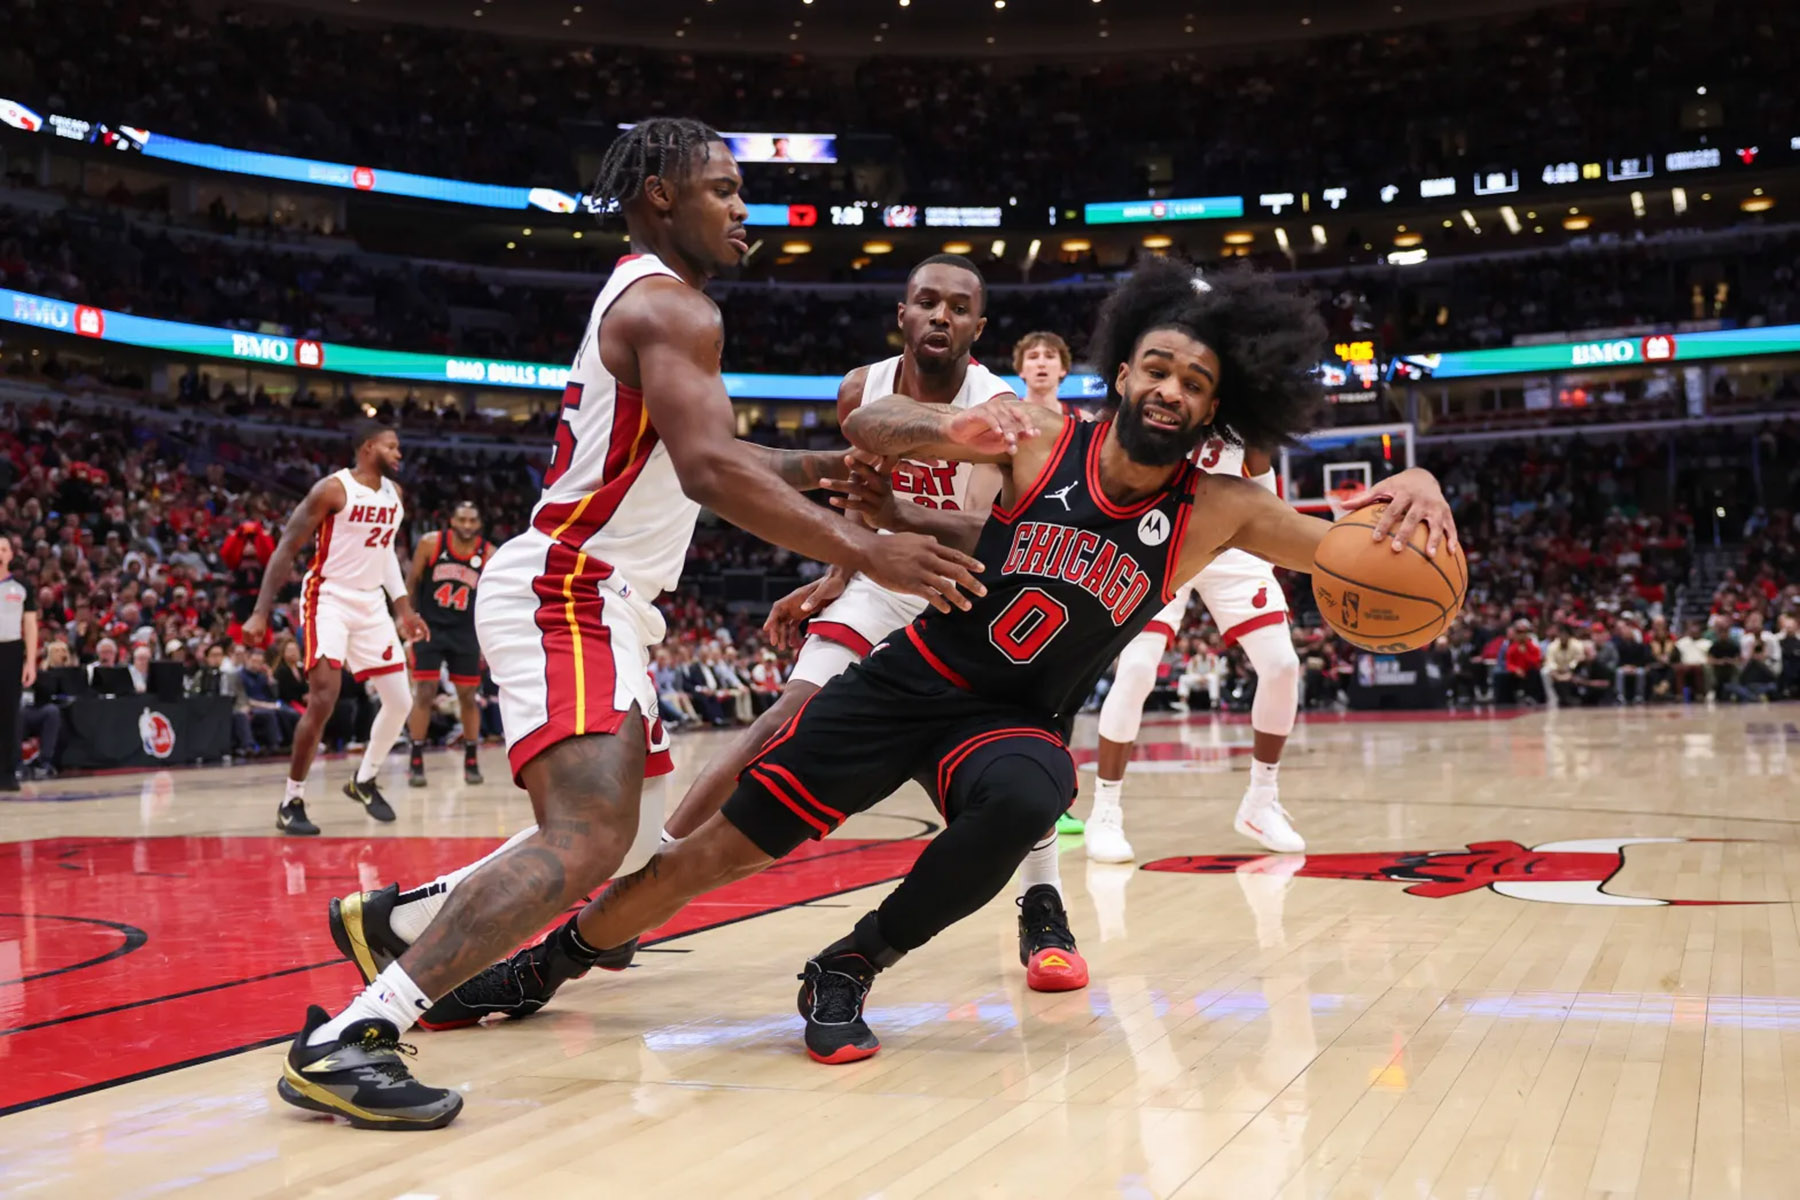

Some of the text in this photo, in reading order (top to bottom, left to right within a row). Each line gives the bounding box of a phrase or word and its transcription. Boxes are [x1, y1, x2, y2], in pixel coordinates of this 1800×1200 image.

[232, 333, 289, 362] BMO
[1571, 341, 1635, 365] BMO
[488, 362, 536, 384] BULLS
[891, 461, 960, 496] EAT
[349, 503, 398, 524] HEAT
[364, 527, 394, 548] 24
[1001, 521, 1151, 627] CHICAGO
[433, 582, 470, 611] 44
[988, 587, 1069, 664] 0
